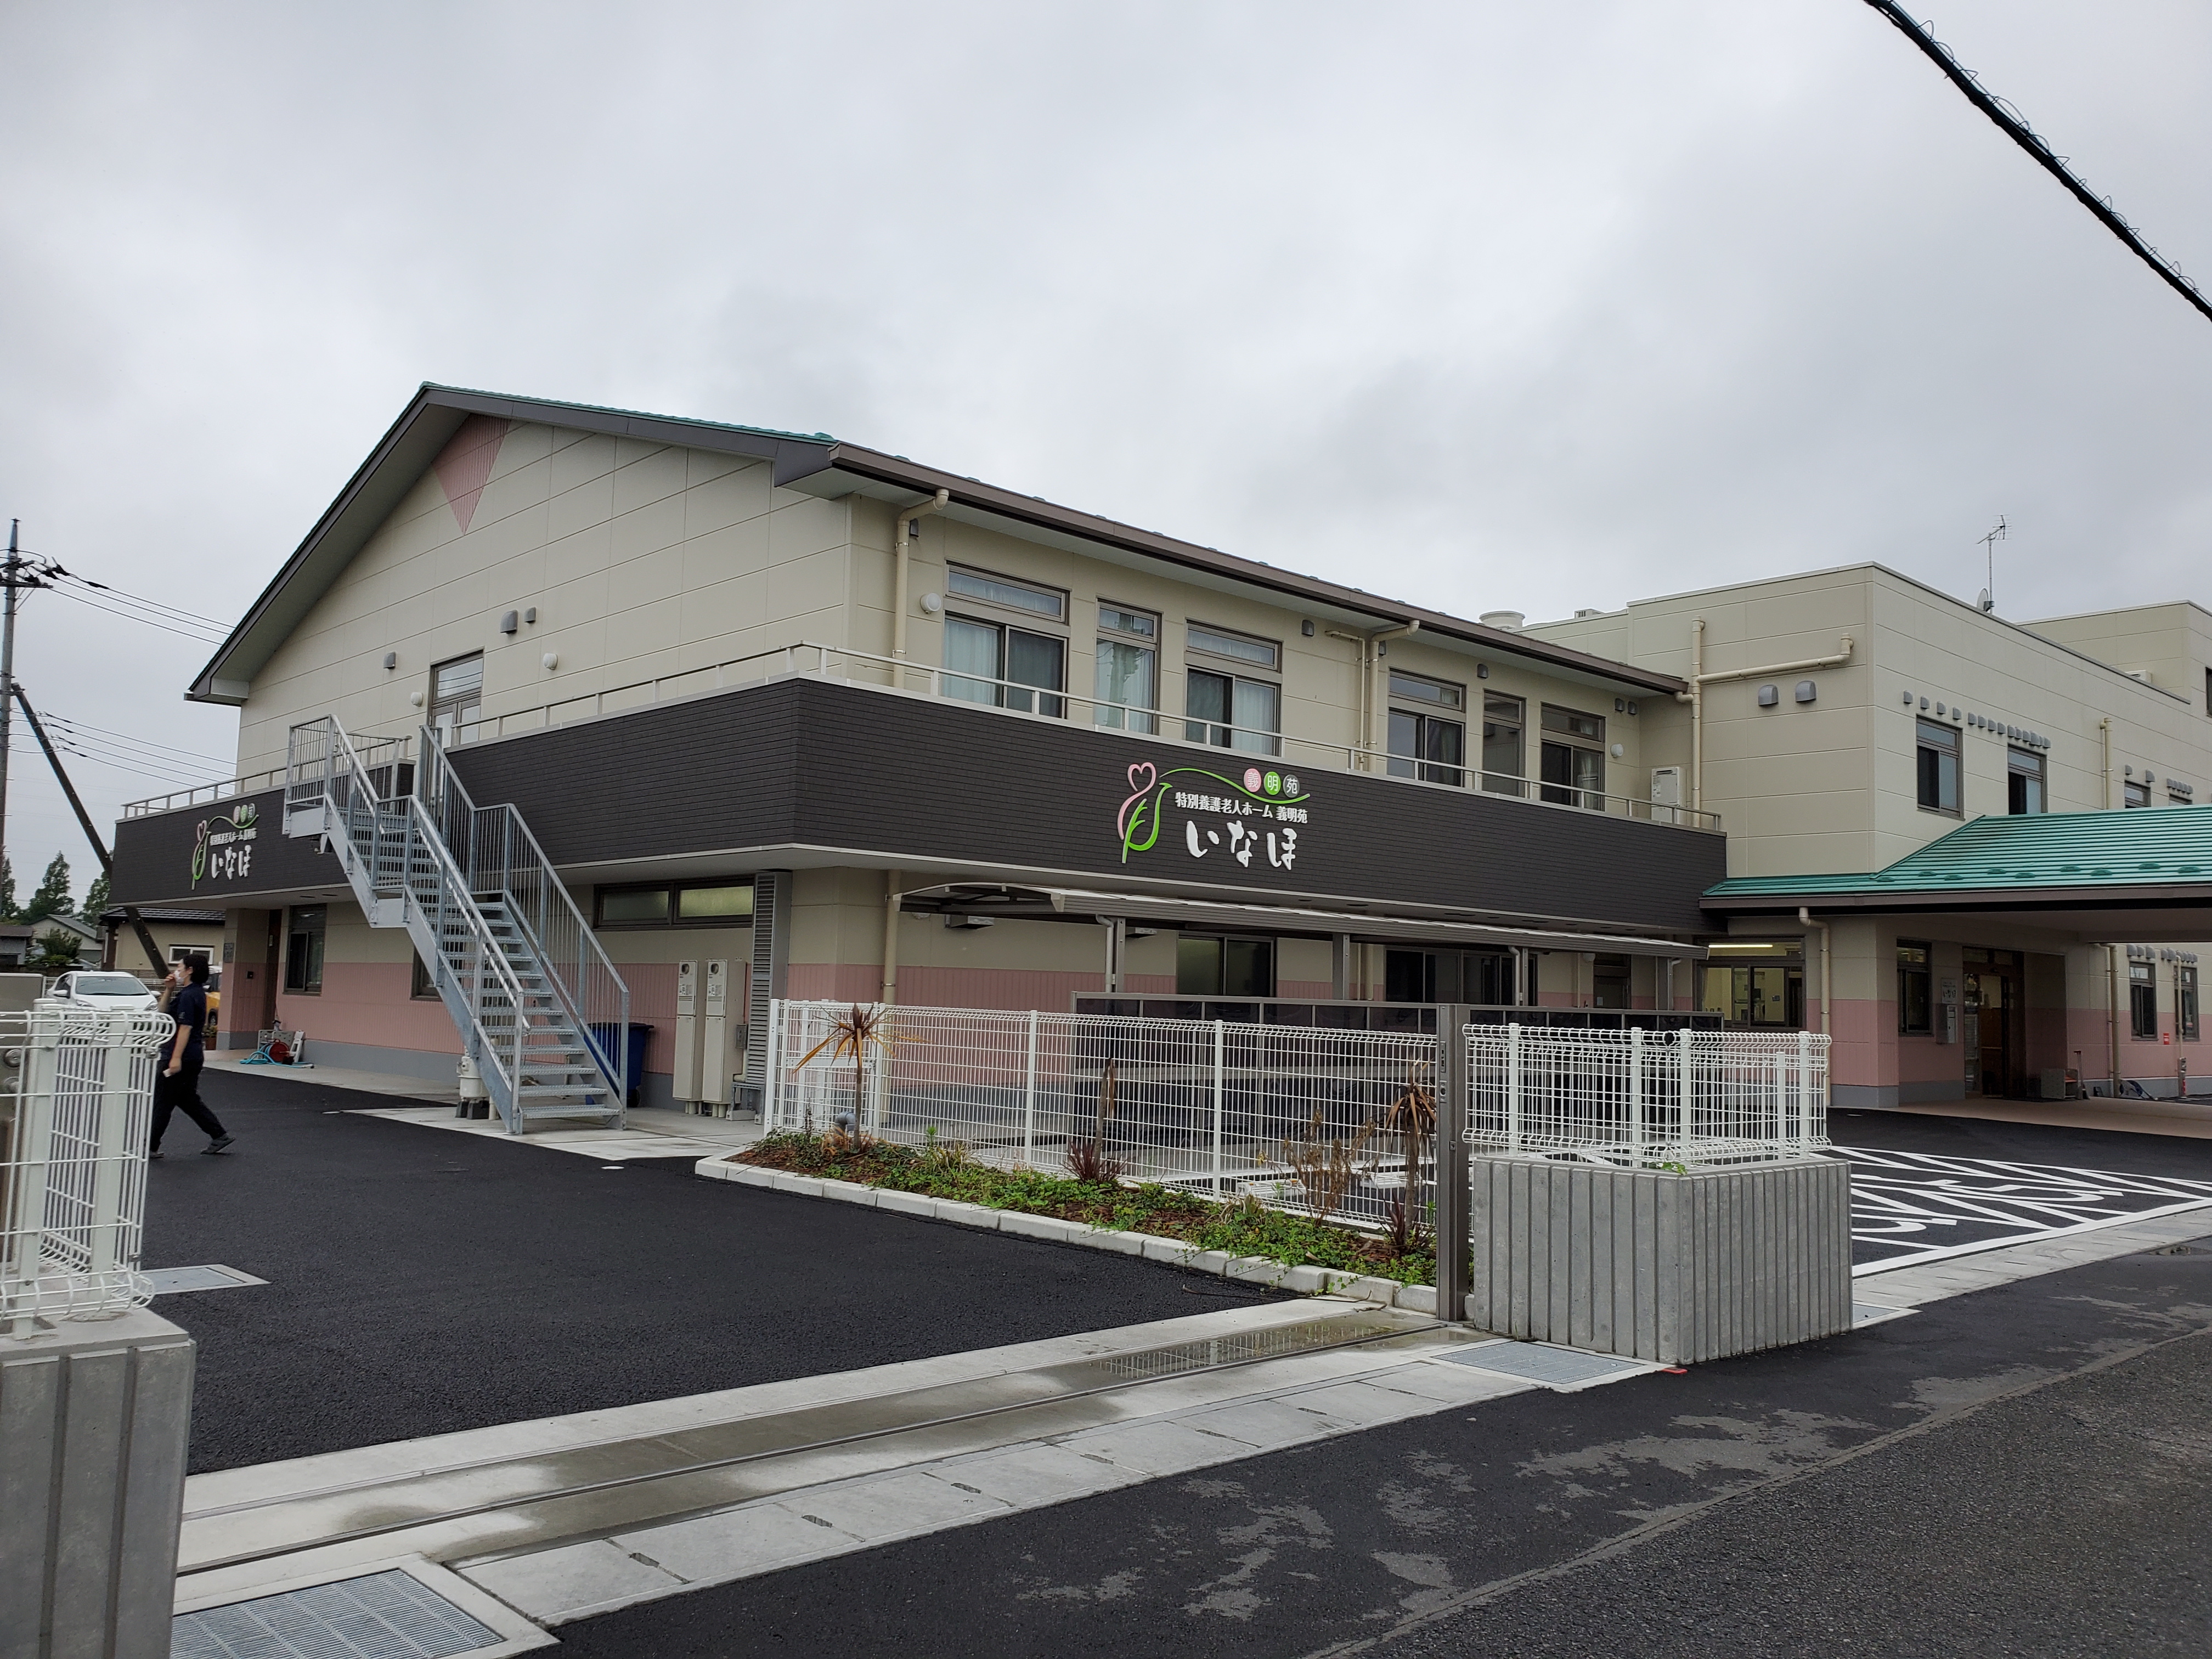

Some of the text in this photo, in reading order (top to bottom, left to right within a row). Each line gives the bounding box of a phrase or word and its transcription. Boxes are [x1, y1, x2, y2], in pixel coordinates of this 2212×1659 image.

[1247, 771, 1298, 794] 義明苑
[1175, 792, 1308, 824] 特別養護老人ホーム 義明苑
[1186, 820, 1297, 871] いなほ
[211, 845, 252, 880] いなほ
